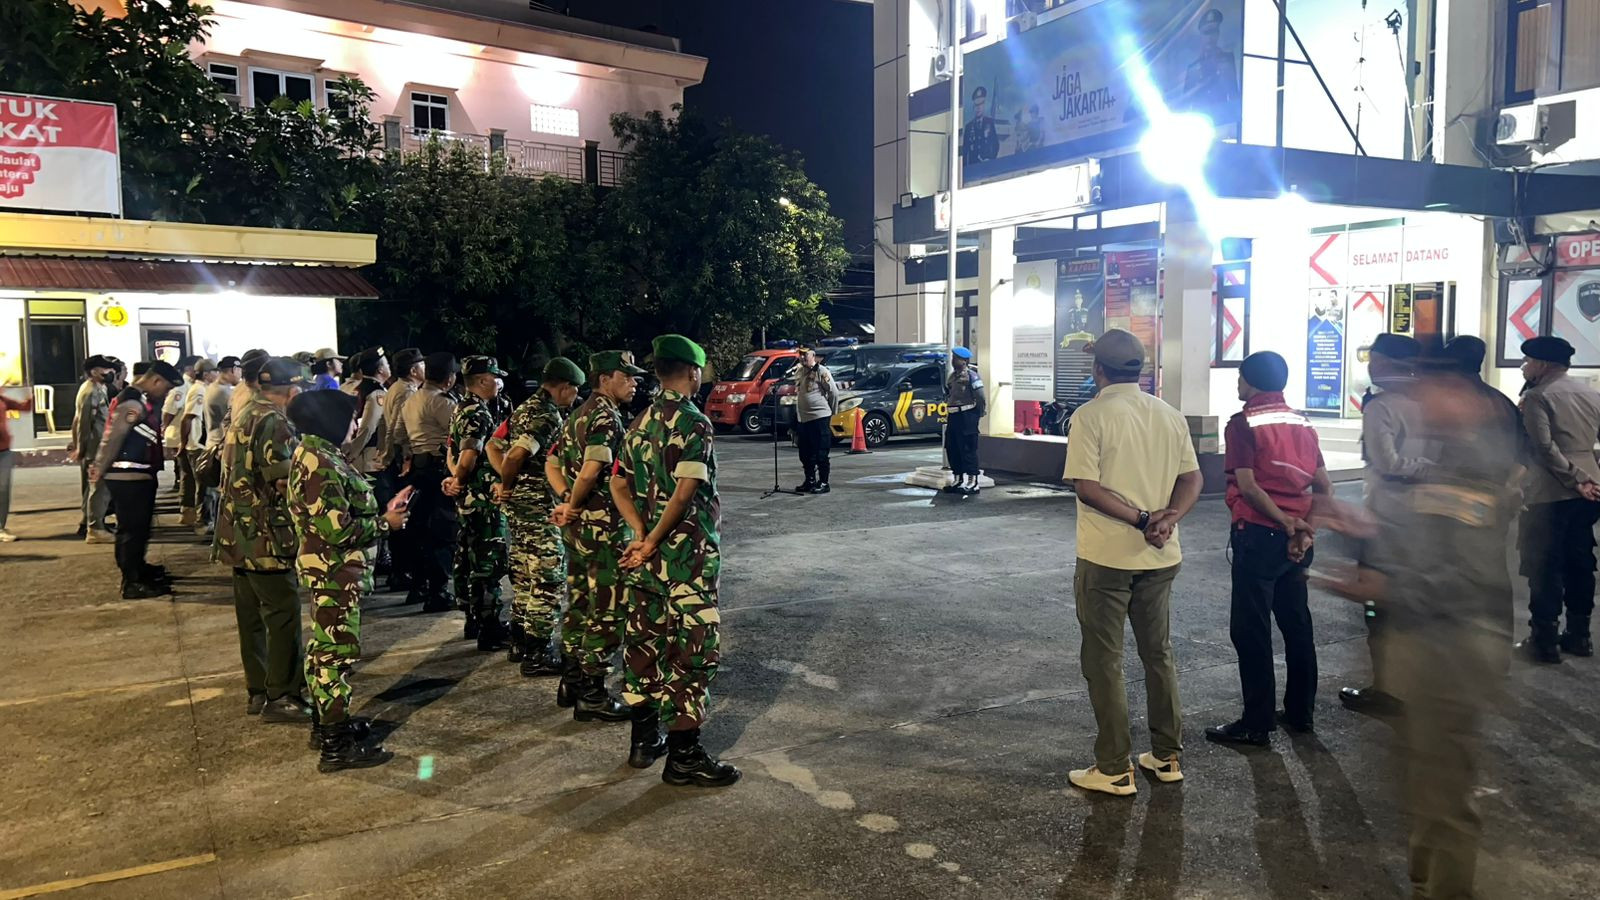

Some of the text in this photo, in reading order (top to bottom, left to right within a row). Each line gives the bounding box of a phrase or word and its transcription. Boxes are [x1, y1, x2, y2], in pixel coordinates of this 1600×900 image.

[1052, 71, 1082, 101] JAGA
[1353, 247, 1449, 266] SELAMAT DATANG
[1569, 240, 1600, 258] OPE
